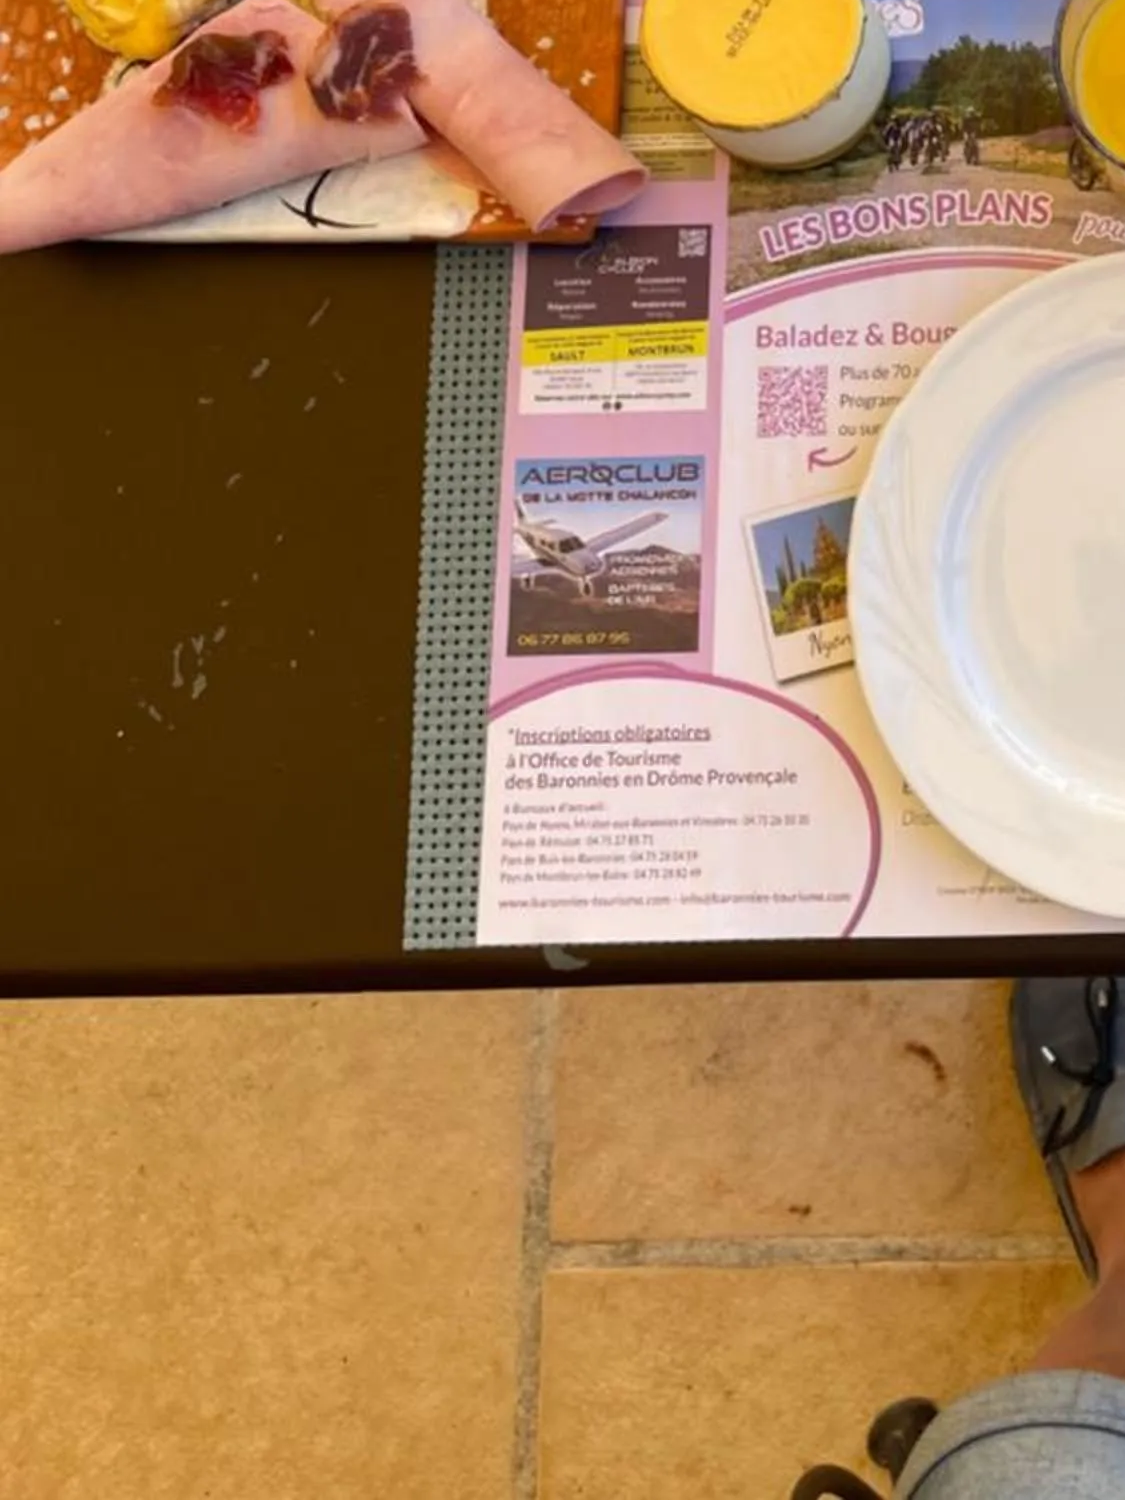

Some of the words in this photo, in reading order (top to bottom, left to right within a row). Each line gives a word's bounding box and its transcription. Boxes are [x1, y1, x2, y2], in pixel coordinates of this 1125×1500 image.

[761, 214, 826, 261] LES
[827, 194, 929, 242] BONS
[934, 191, 1053, 226] PLANS
[755, 323, 859, 349] Baladez
[864, 321, 885, 347] &
[839, 365, 870, 381] Plus
[872, 364, 890, 380] de
[891, 363, 912, 380] 70
[837, 423, 856, 437] ou
[520, 461, 700, 486] AEROCLUB
[521, 492, 541, 505] DE
[544, 492, 563, 504] LA
[565, 490, 614, 504] MOTTE
[616, 488, 698, 502] CHALANCON
[614, 723, 711, 745] obligatoires
[505, 753, 516, 769] à
[518, 751, 579, 769] l'Office
[581, 751, 604, 768] de
[606, 749, 682, 767] Tourisme
[504, 772, 533, 790] des
[536, 771, 620, 789] Baronnies
[623, 774, 644, 787] en
[646, 768, 704, 787] Drôme
[706, 767, 799, 789] Provençale
